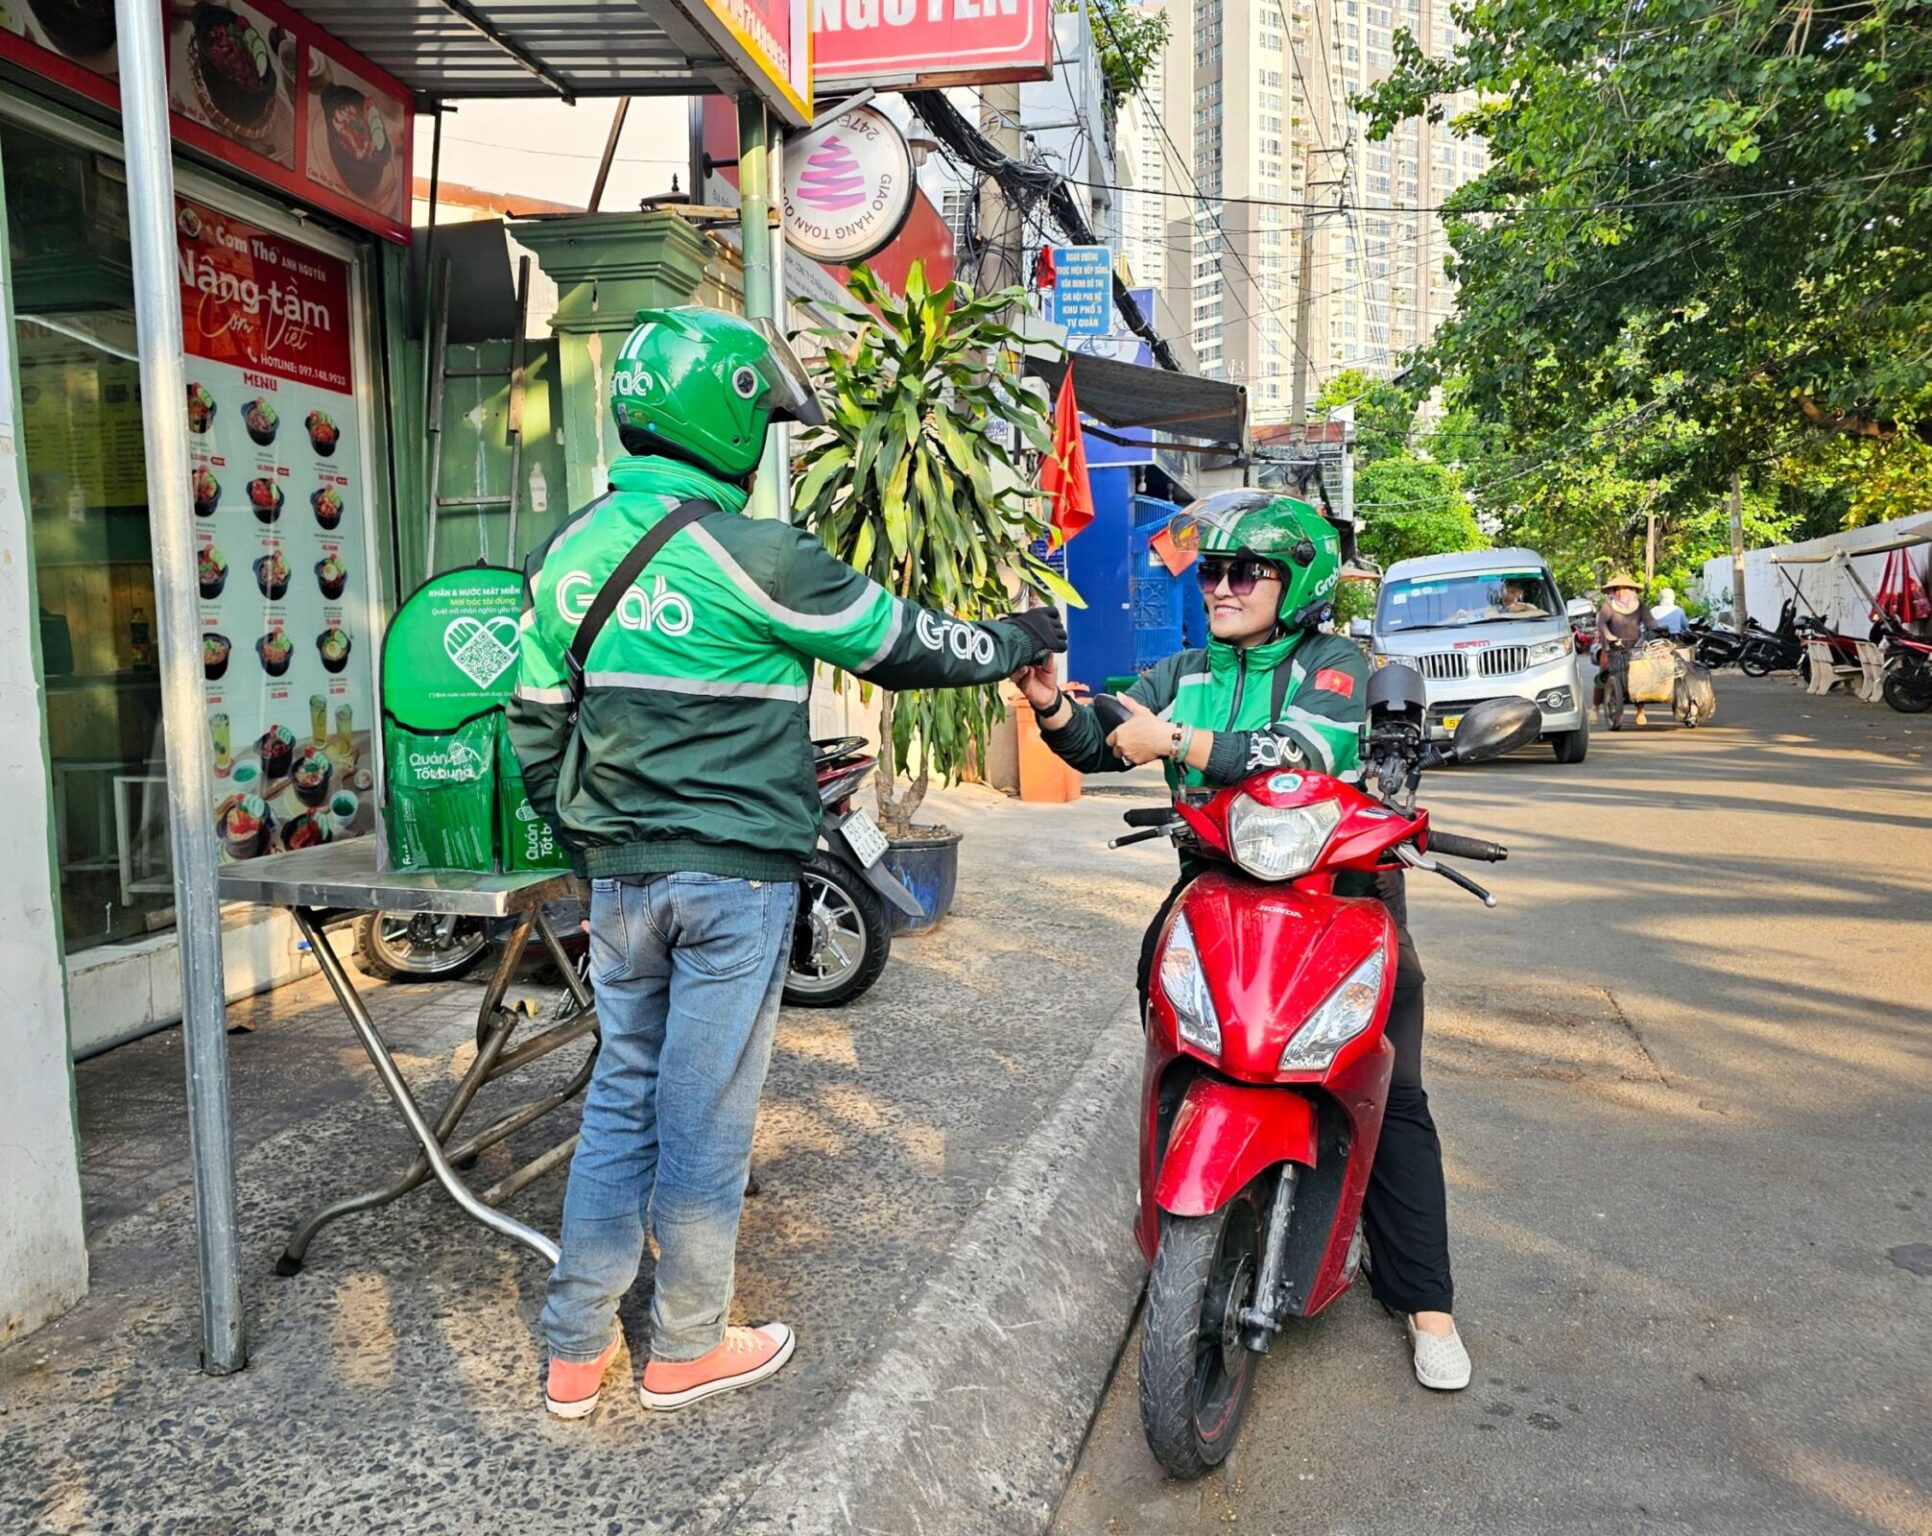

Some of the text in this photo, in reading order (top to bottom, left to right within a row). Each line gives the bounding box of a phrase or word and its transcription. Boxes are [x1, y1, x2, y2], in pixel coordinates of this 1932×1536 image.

[872, 173, 892, 211] GIAO
[794, 216, 831, 240] TOÀN
[836, 210, 876, 239] HÀNG
[281, 256, 298, 271] ANH
[178, 248, 331, 331] Nâng tầm
[1062, 305, 1078, 314] KHU
[1079, 302, 1096, 314] PHỐ
[260, 353, 298, 374] HOTLINE:
[243, 371, 278, 391] MENU
[555, 570, 694, 637] Gab
[409, 751, 448, 767] Quán
[524, 823, 539, 860] Quán
[538, 837, 554, 857] Tốt
[1257, 904, 1303, 919] HONDA
